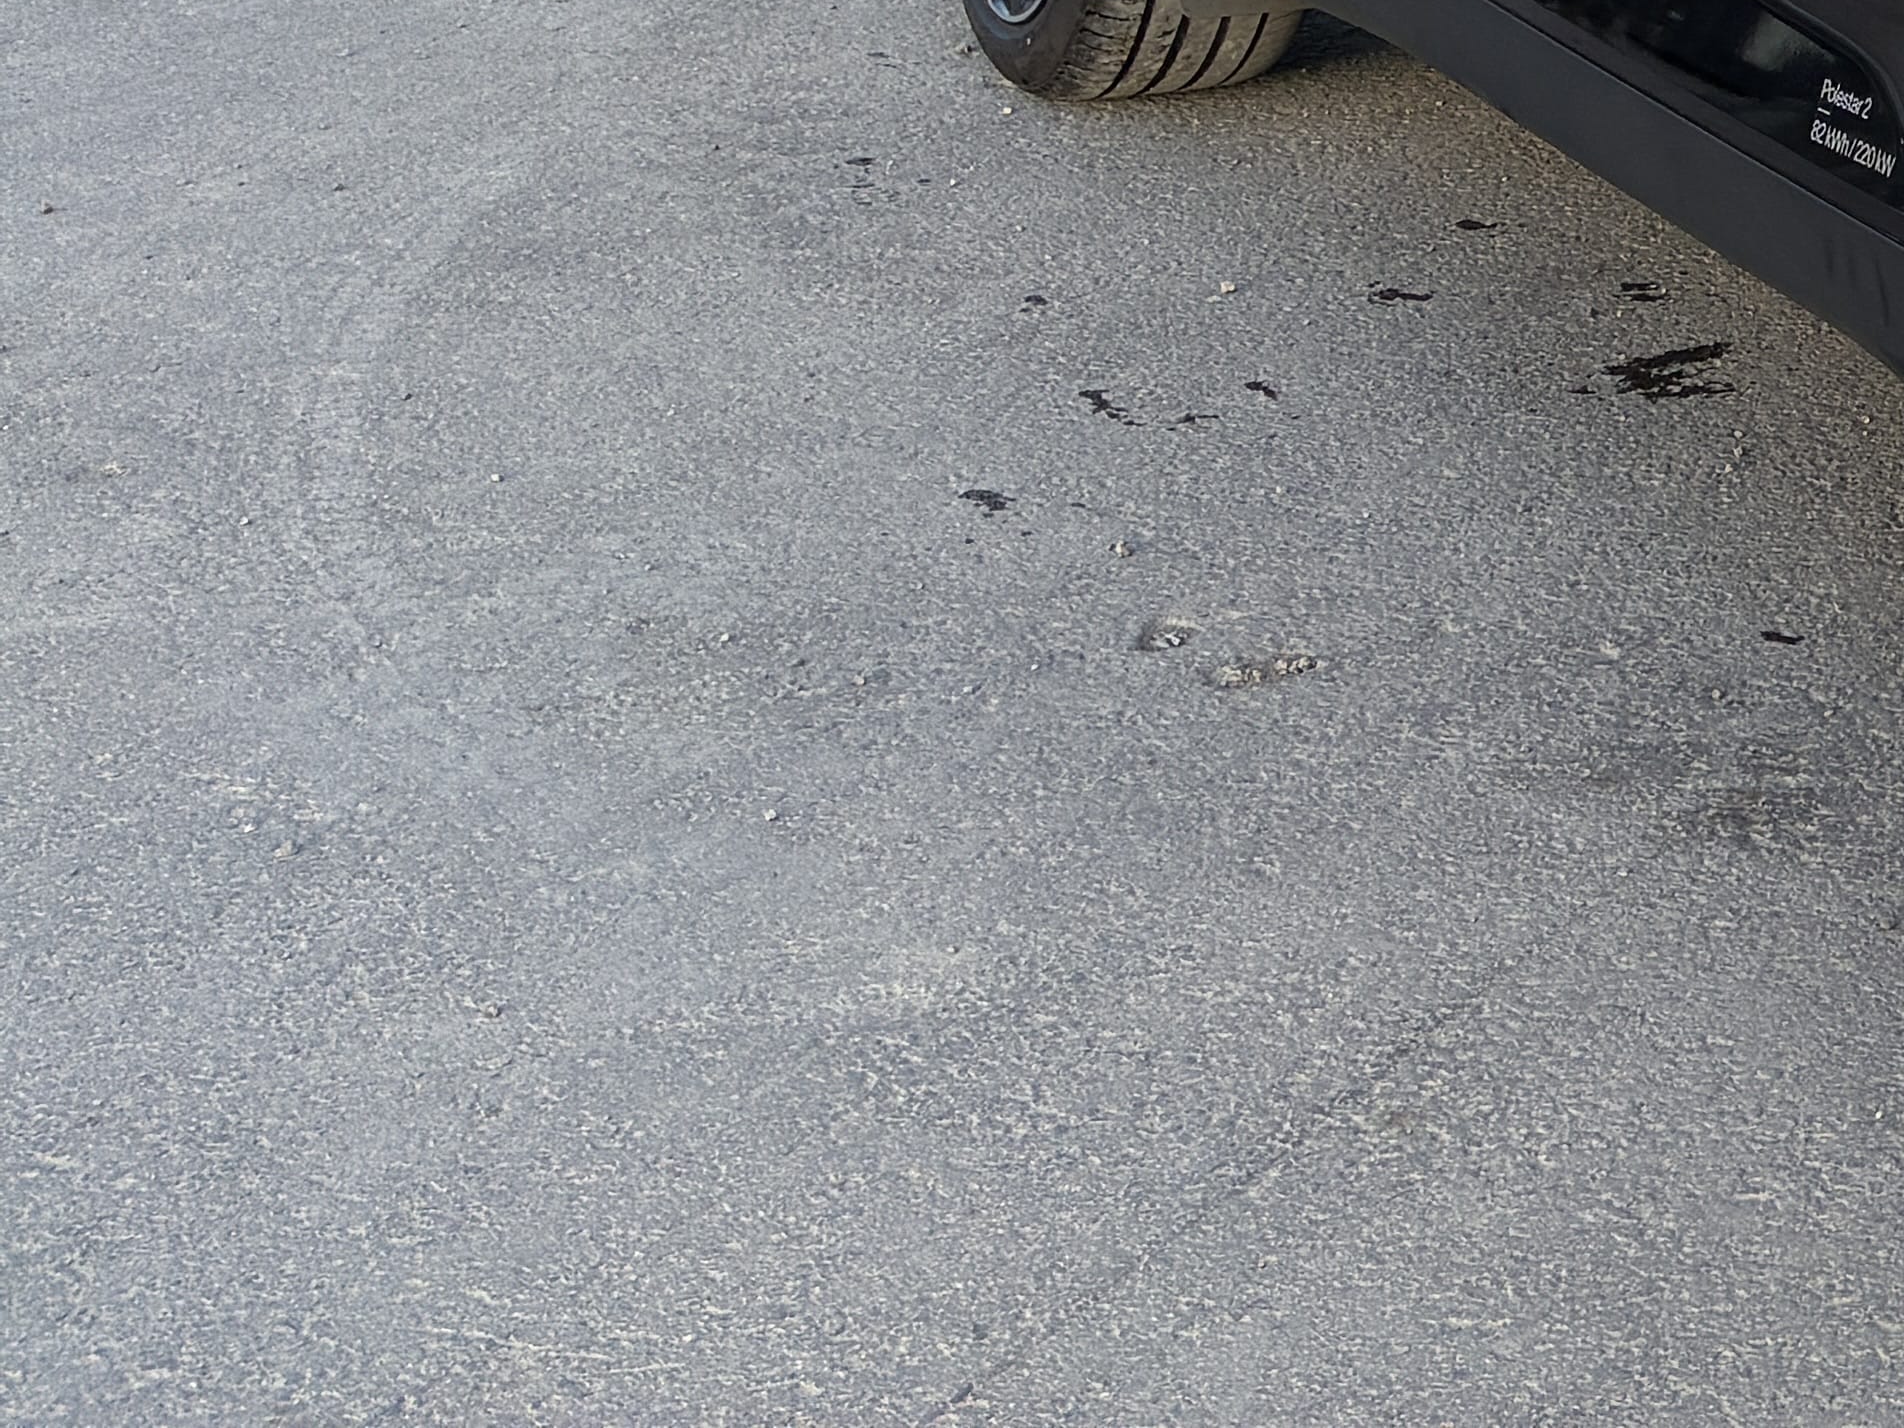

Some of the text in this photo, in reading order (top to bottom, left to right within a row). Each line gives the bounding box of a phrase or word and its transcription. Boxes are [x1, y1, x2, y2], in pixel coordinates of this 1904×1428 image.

[1820, 78, 1872, 119] Polestar 2
[1810, 119, 1827, 144] 82
[1853, 140, 1876, 168] 220
[1875, 148, 1897, 178] kW
